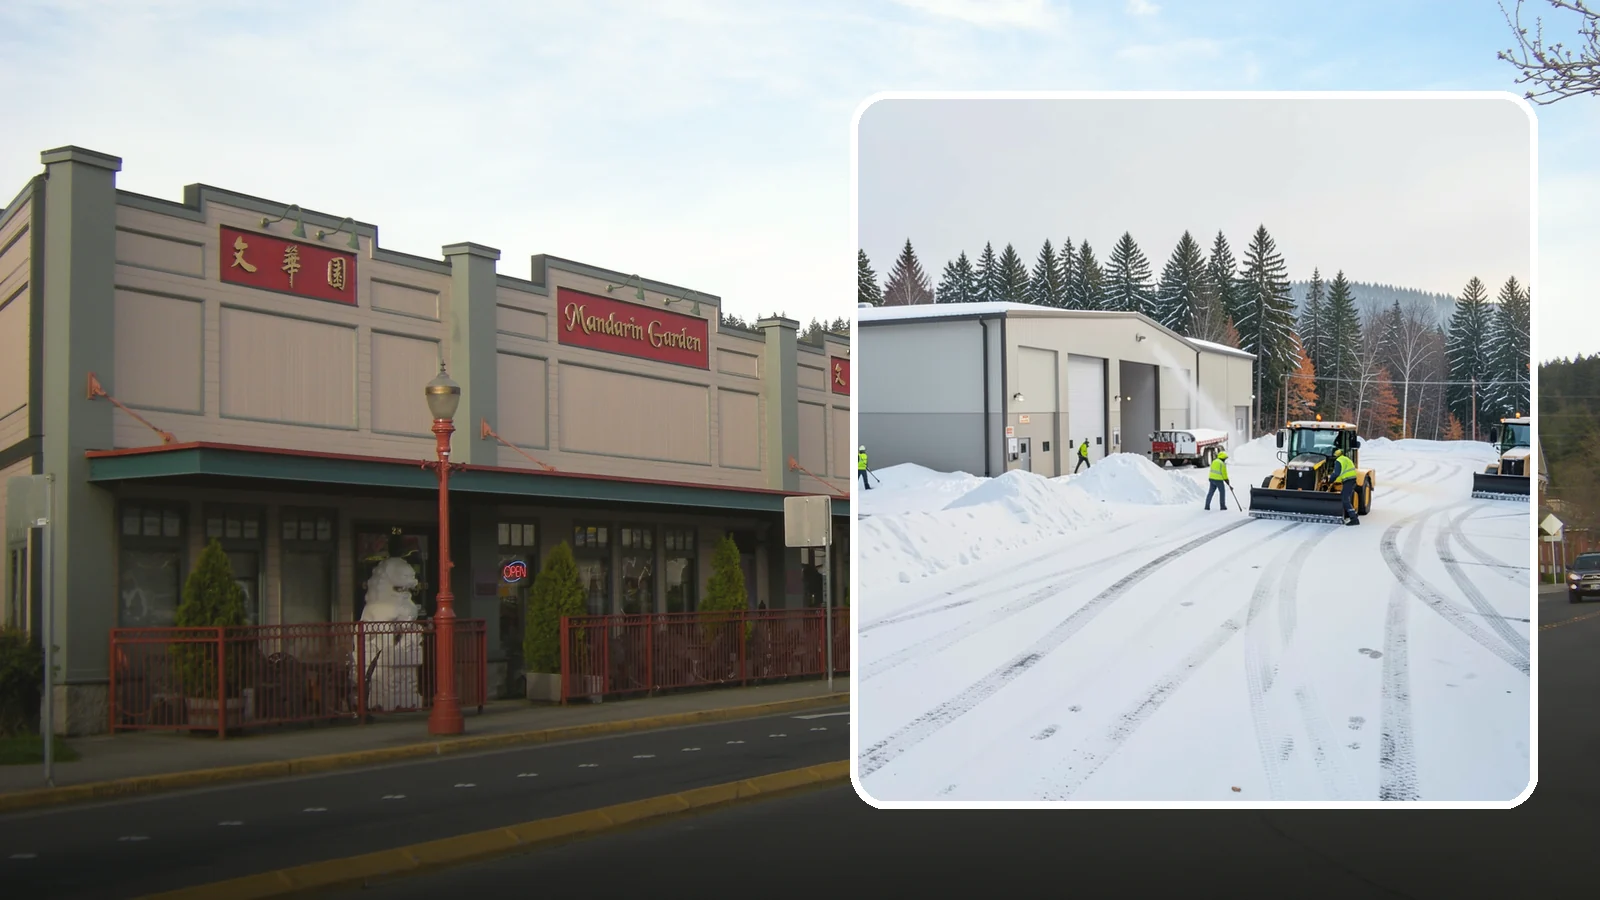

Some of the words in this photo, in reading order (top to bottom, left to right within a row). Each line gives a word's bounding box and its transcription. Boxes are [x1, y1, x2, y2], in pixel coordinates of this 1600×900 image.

[231, 235, 346, 291] 文華園
[564, 302, 644, 341] Mandarin
[648, 320, 701, 352] Garden
[503, 565, 527, 578] OPEN
